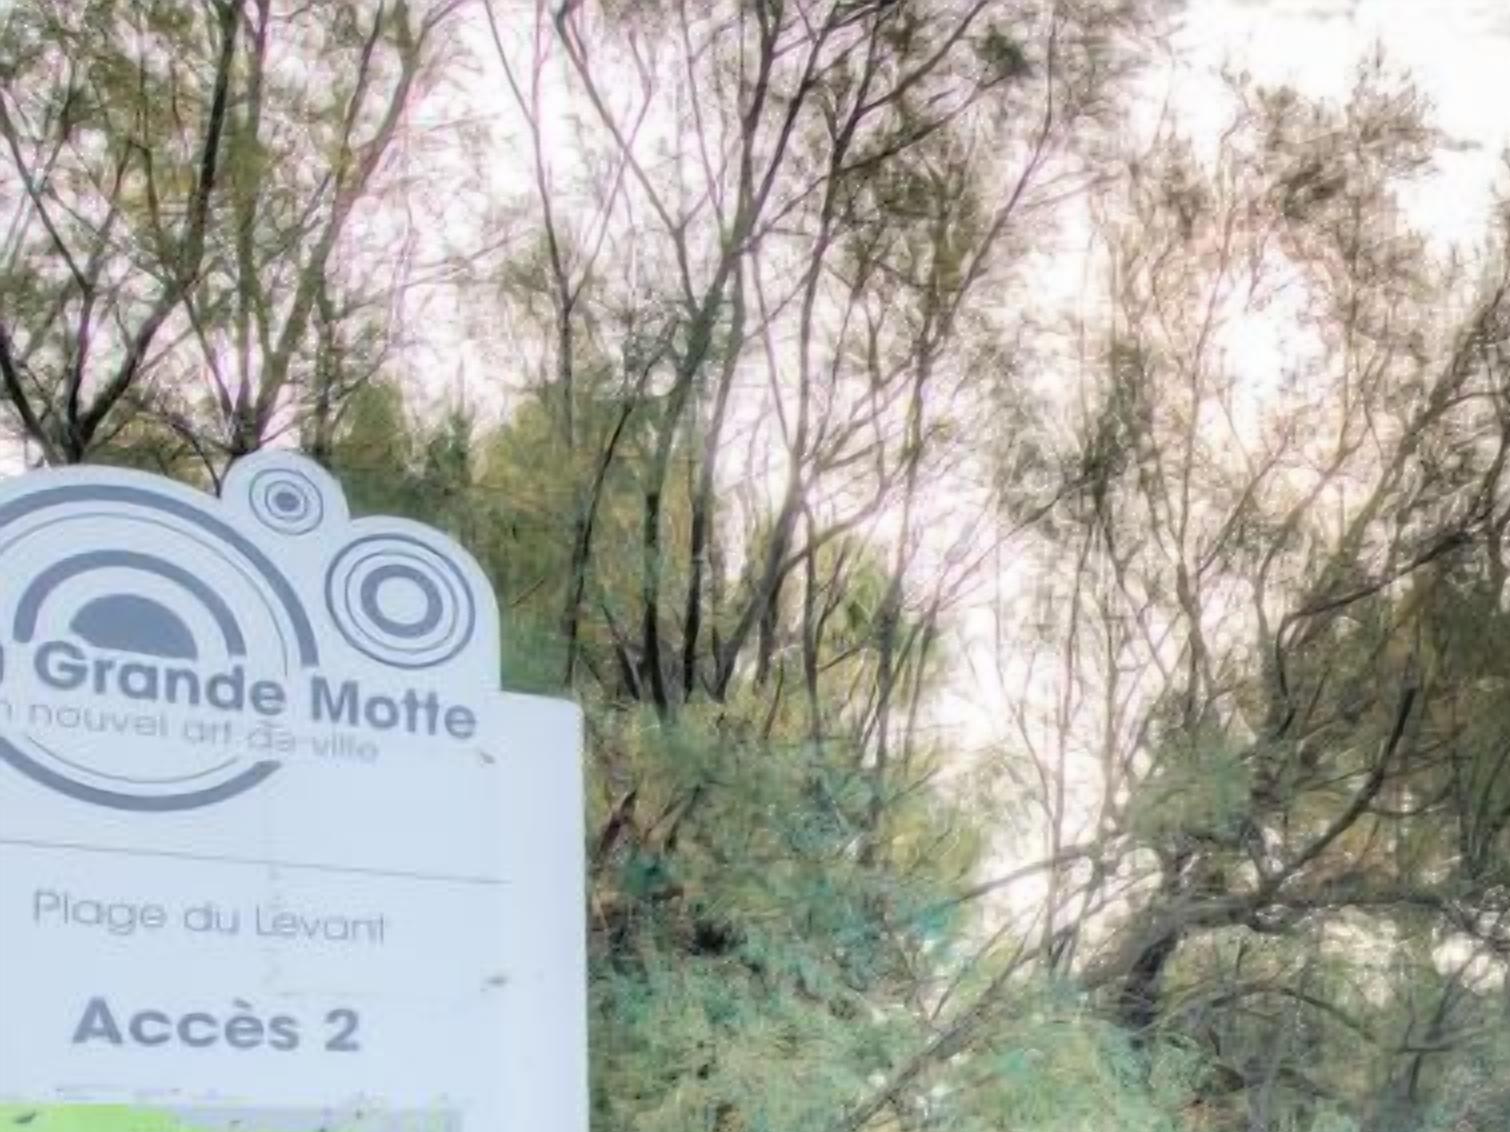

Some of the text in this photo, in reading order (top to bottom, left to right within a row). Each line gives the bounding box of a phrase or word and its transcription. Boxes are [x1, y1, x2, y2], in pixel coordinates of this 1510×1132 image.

[34, 639, 286, 716] Grande
[310, 675, 478, 740] Motte
[28, 702, 168, 738] nouvel
[31, 888, 167, 935] Plage
[183, 900, 240, 935] du
[71, 997, 362, 1053] Accès 2
